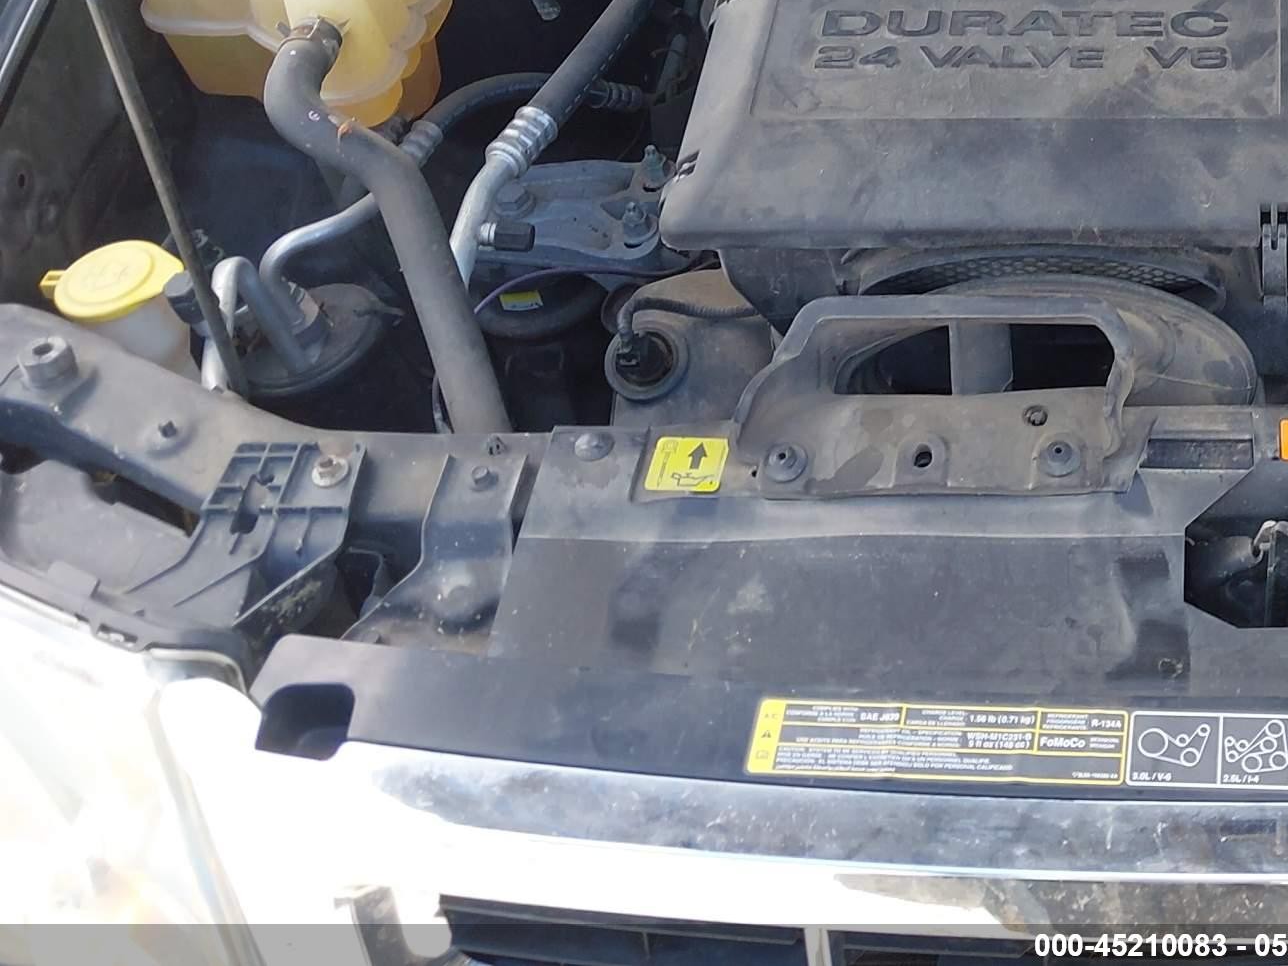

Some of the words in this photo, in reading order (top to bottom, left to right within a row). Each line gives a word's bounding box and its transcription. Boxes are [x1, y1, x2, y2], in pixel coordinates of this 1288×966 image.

[822, 10, 1229, 38] DURATEC
[814, 45, 901, 69] 24
[919, 45, 1104, 69] VALVE
[1144, 46, 1229, 69] V6
[1091, 718, 1122, 729] R-134A
[1039, 736, 1086, 749] FoMoCo
